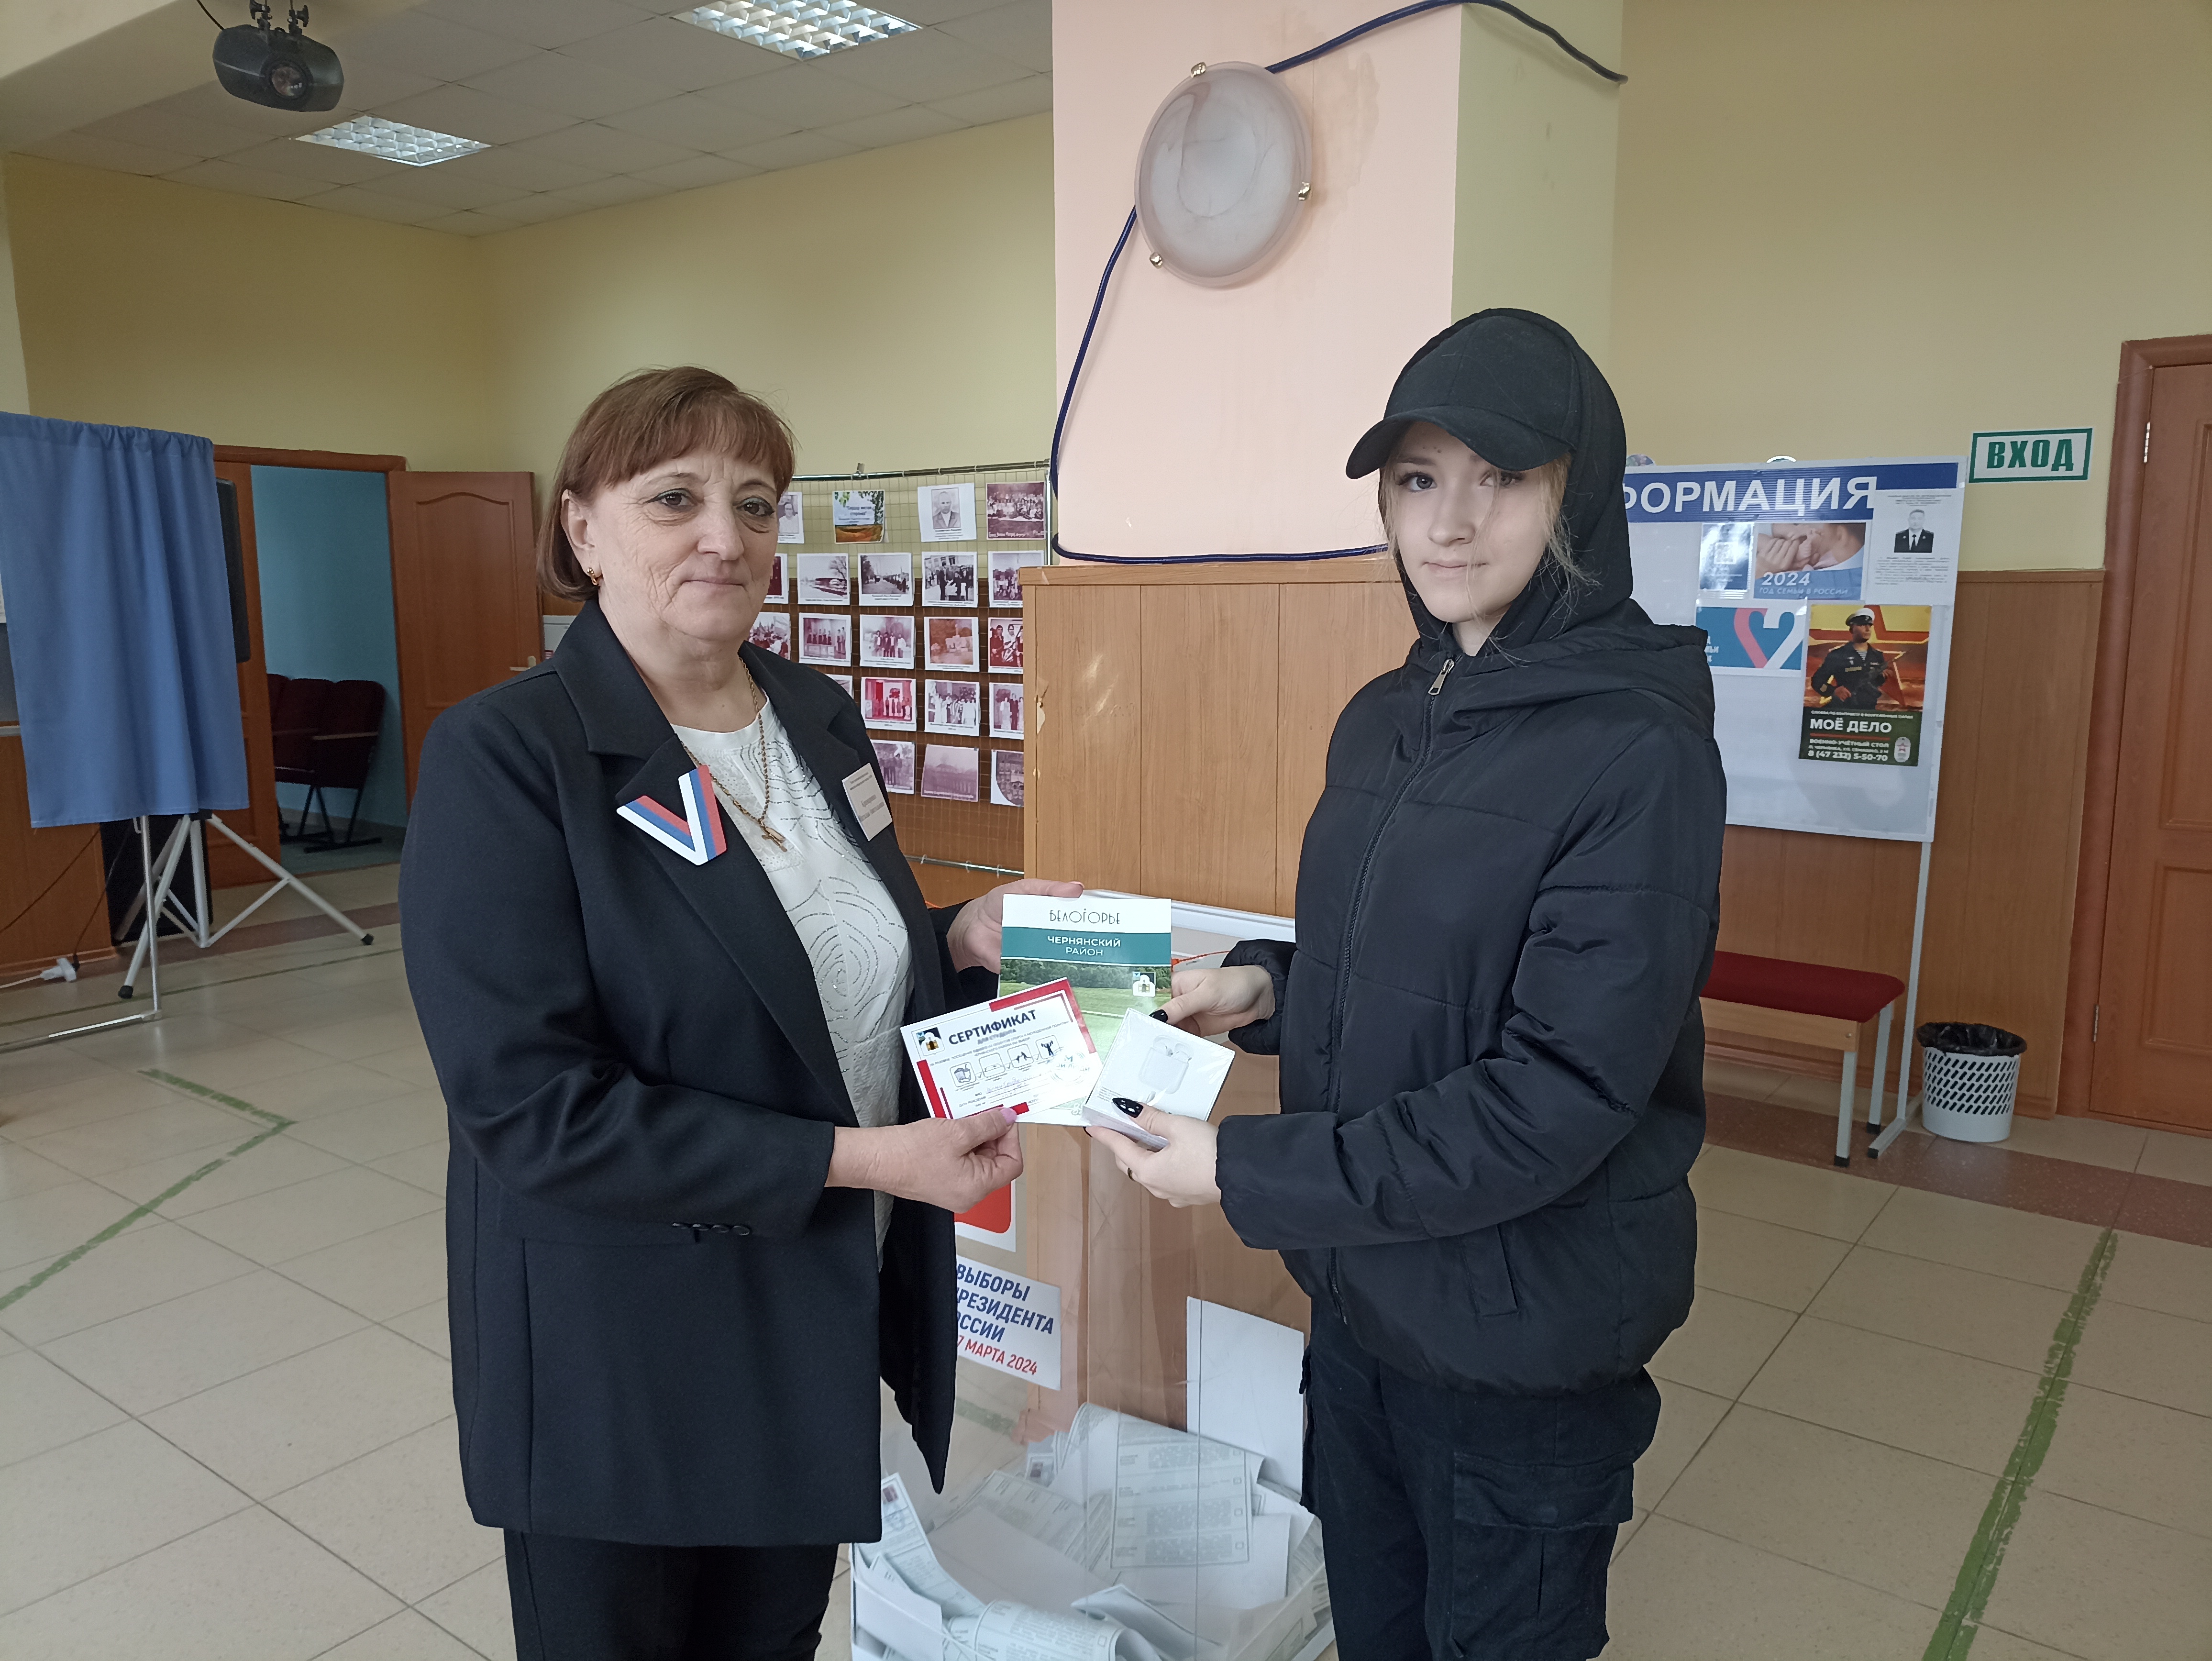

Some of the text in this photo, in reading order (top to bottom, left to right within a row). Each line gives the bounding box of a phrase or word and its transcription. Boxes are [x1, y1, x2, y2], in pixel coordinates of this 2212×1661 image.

[1987, 439, 2074, 471] ВХОД
[1761, 572, 1810, 586] 2024
[1810, 717, 1892, 733] МОЁ ДЕЛО
[1816, 750, 1830, 759] (47
[1853, 753, 1888, 762] 5-50-70
[1047, 936, 1121, 947] ЧЕРНЯНСКИЙ
[1066, 947, 1103, 956] РАЙОН
[949, 1009, 1037, 1045] СЕРТИФИКАТ
[957, 1263, 1030, 1301] ВЫБОРЫ
[964, 1339, 1005, 1364] МАРТА
[1006, 1353, 1037, 1375] 2024
